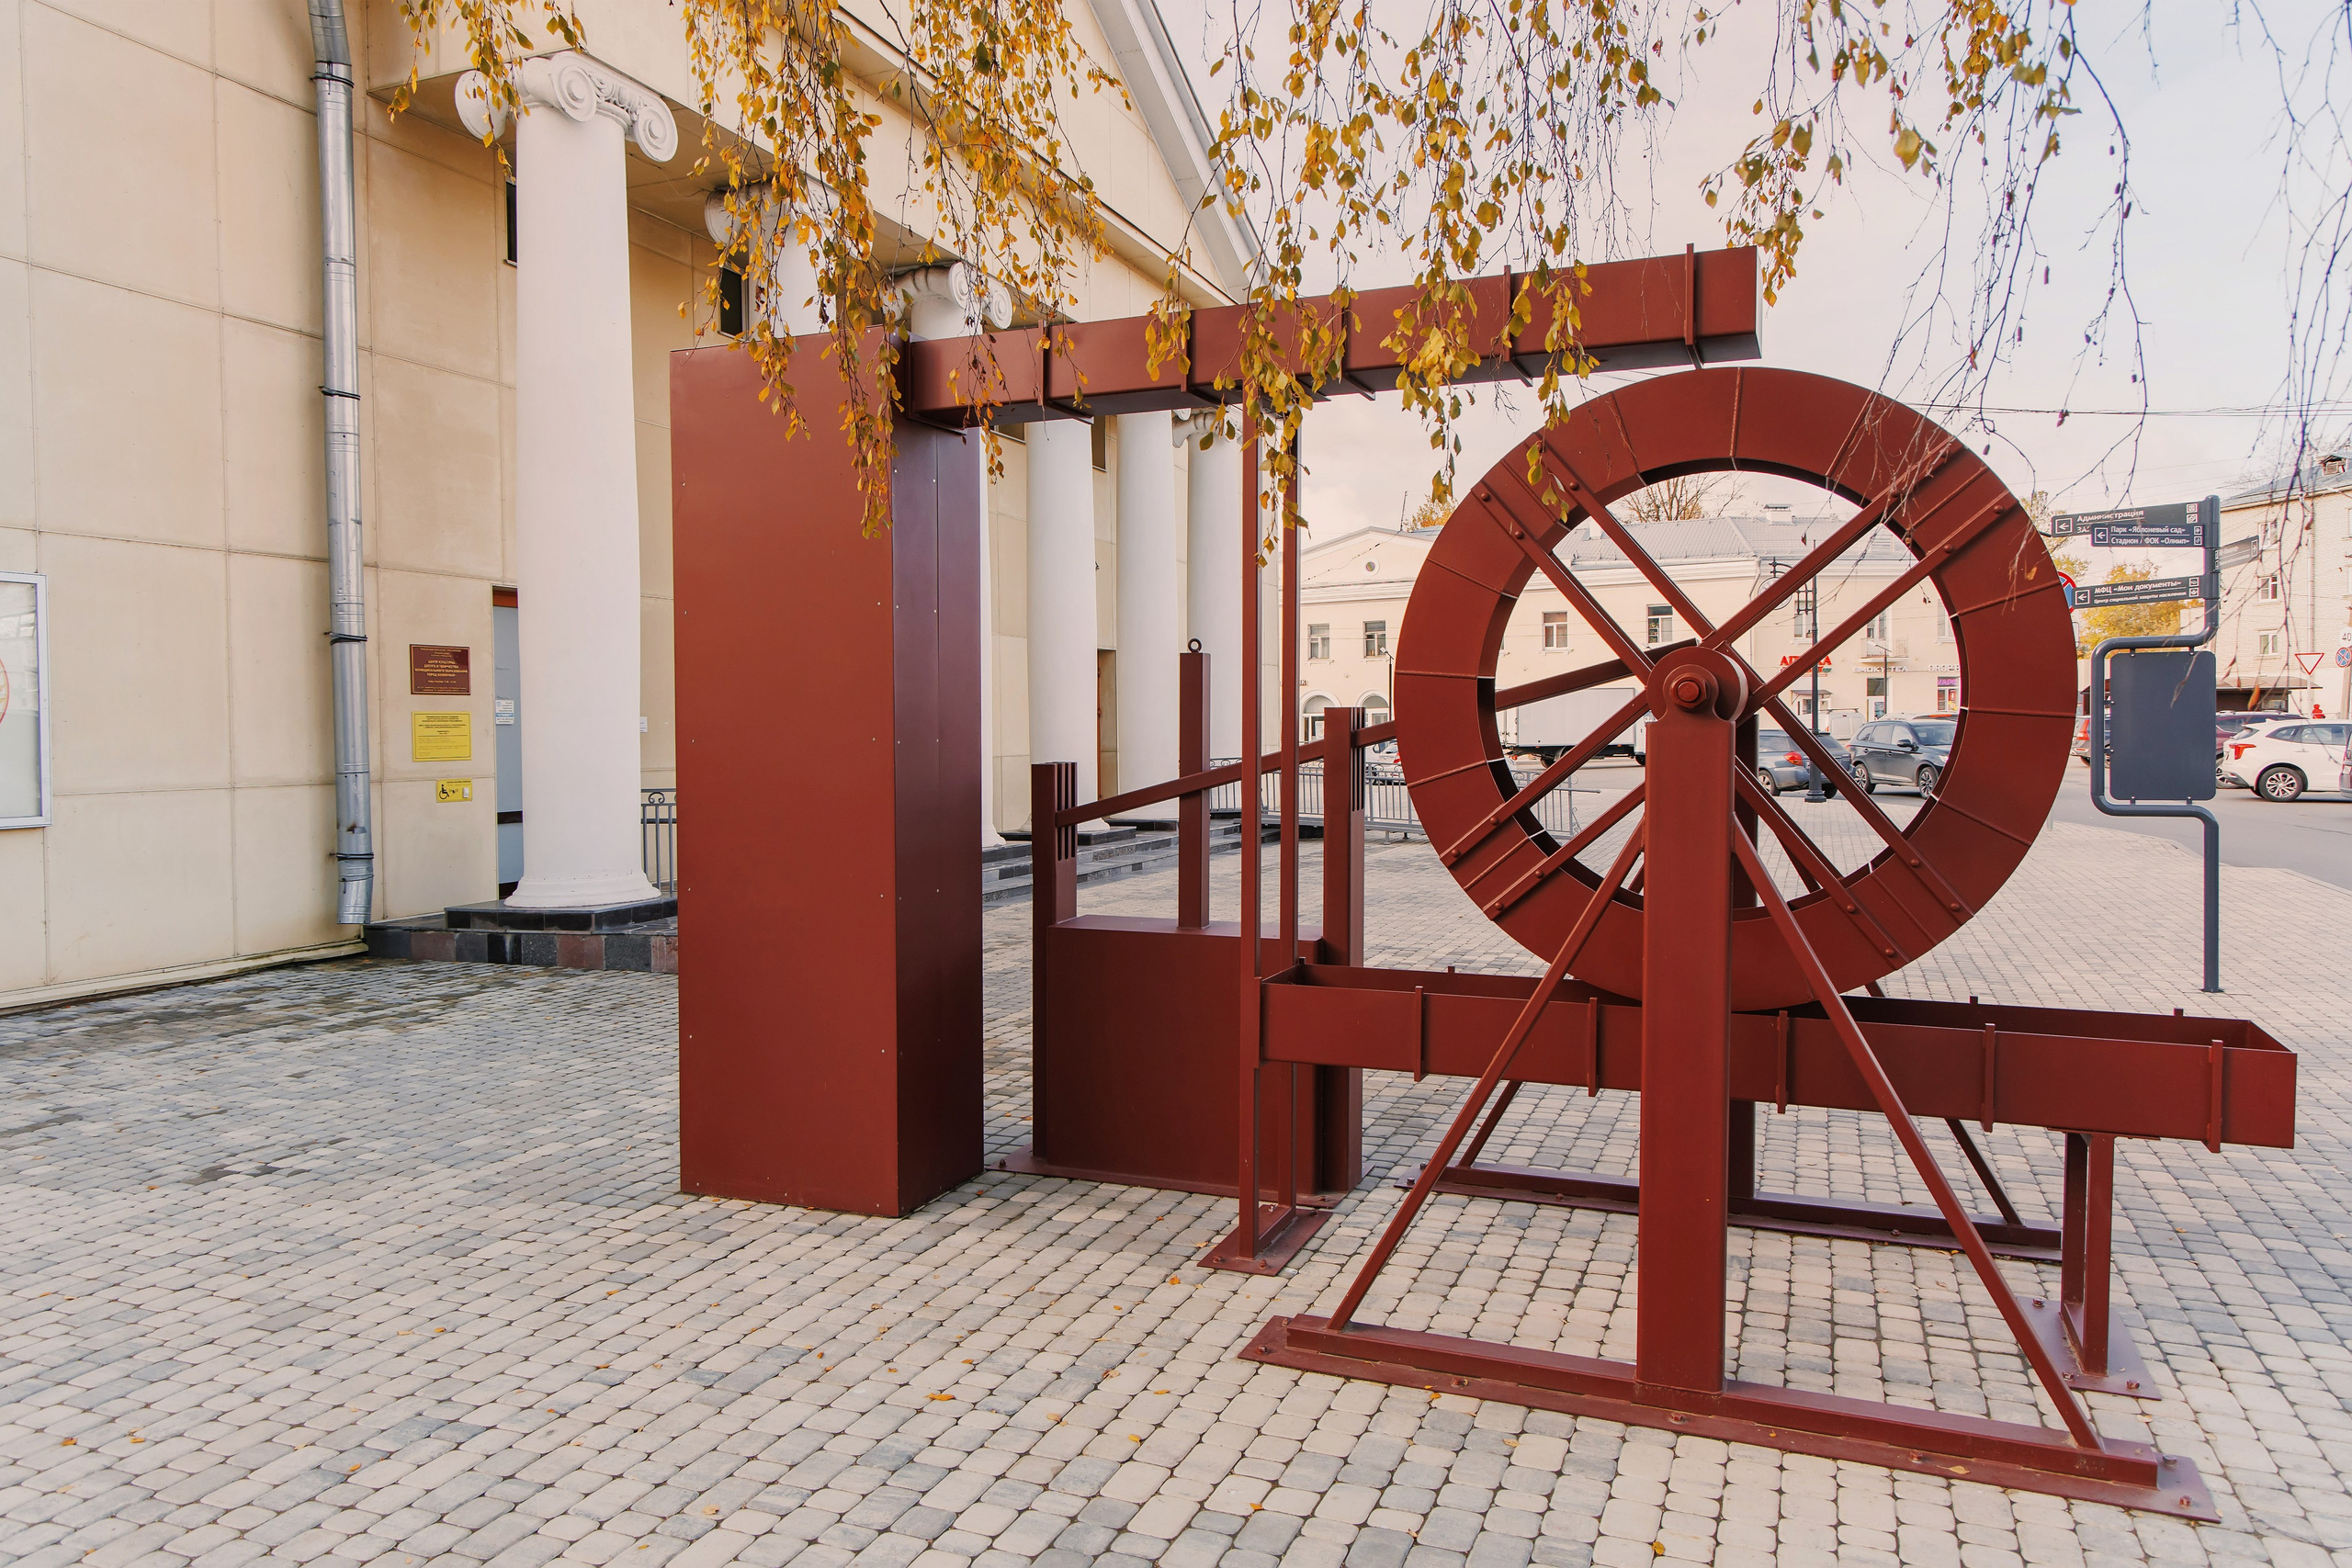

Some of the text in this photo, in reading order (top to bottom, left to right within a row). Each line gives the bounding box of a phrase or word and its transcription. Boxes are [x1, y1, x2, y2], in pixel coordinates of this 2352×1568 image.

[2076, 510, 2143, 523] Администрация
[2095, 581, 2182, 594] МФЦ «Мои документы»
[2342, 633, 2352, 641] 40
